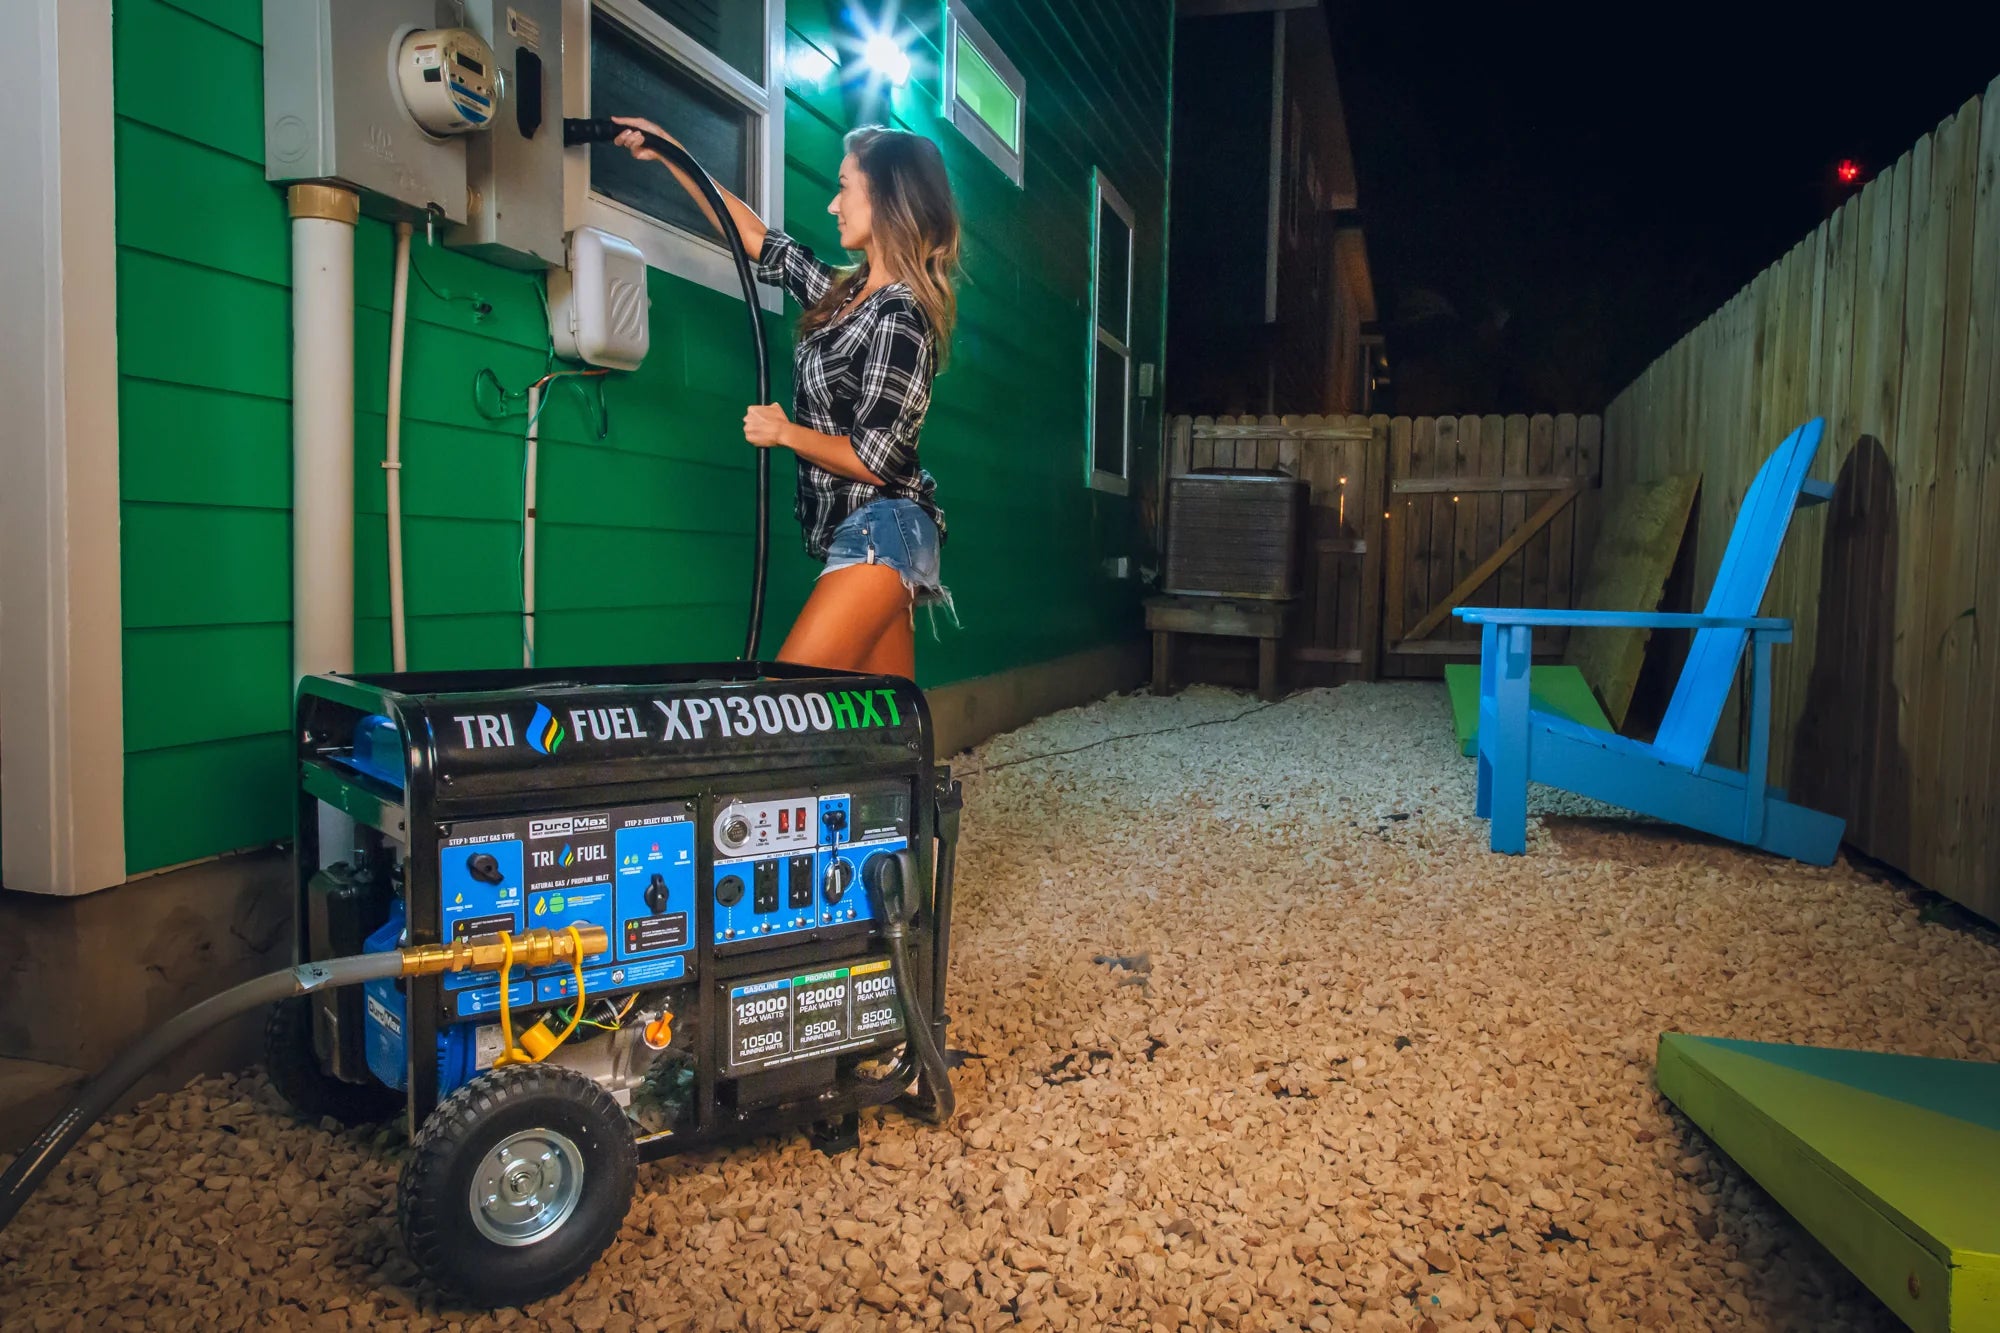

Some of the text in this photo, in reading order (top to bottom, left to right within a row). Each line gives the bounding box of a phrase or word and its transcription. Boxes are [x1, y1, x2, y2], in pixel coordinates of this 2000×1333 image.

[454, 689, 901, 749] TRI FUEL XP13000HXT
[625, 819, 636, 828] STEP
[643, 817, 661, 825] SELECT
[662, 816, 672, 824] FUEL
[449, 838, 462, 846] STEP
[469, 835, 488, 844] SELECT
[532, 845, 607, 868] TRI FUEL
[531, 881, 554, 891] NATURAL
[555, 880, 565, 888] GAS
[571, 876, 593, 886] PROPANE
[596, 874, 609, 882] INLET
[805, 971, 837, 983] PROPANE
[743, 982, 779, 994] GASOLINE
[797, 984, 845, 1006] 12000
[857, 989, 896, 1002] PEAK WATTS
[736, 996, 787, 1018] 13000
[800, 999, 842, 1014] PEAK WATTS
[739, 1010, 784, 1026] PEAK WATTS
[862, 1008, 892, 1024] 8500
[805, 1020, 837, 1036] 9500
[857, 1018, 897, 1031] RUNNING WATTS
[741, 1031, 783, 1049] 10500
[800, 1030, 841, 1043] RUNNING WATTS
[740, 1042, 783, 1057] RUNNING WATTS
